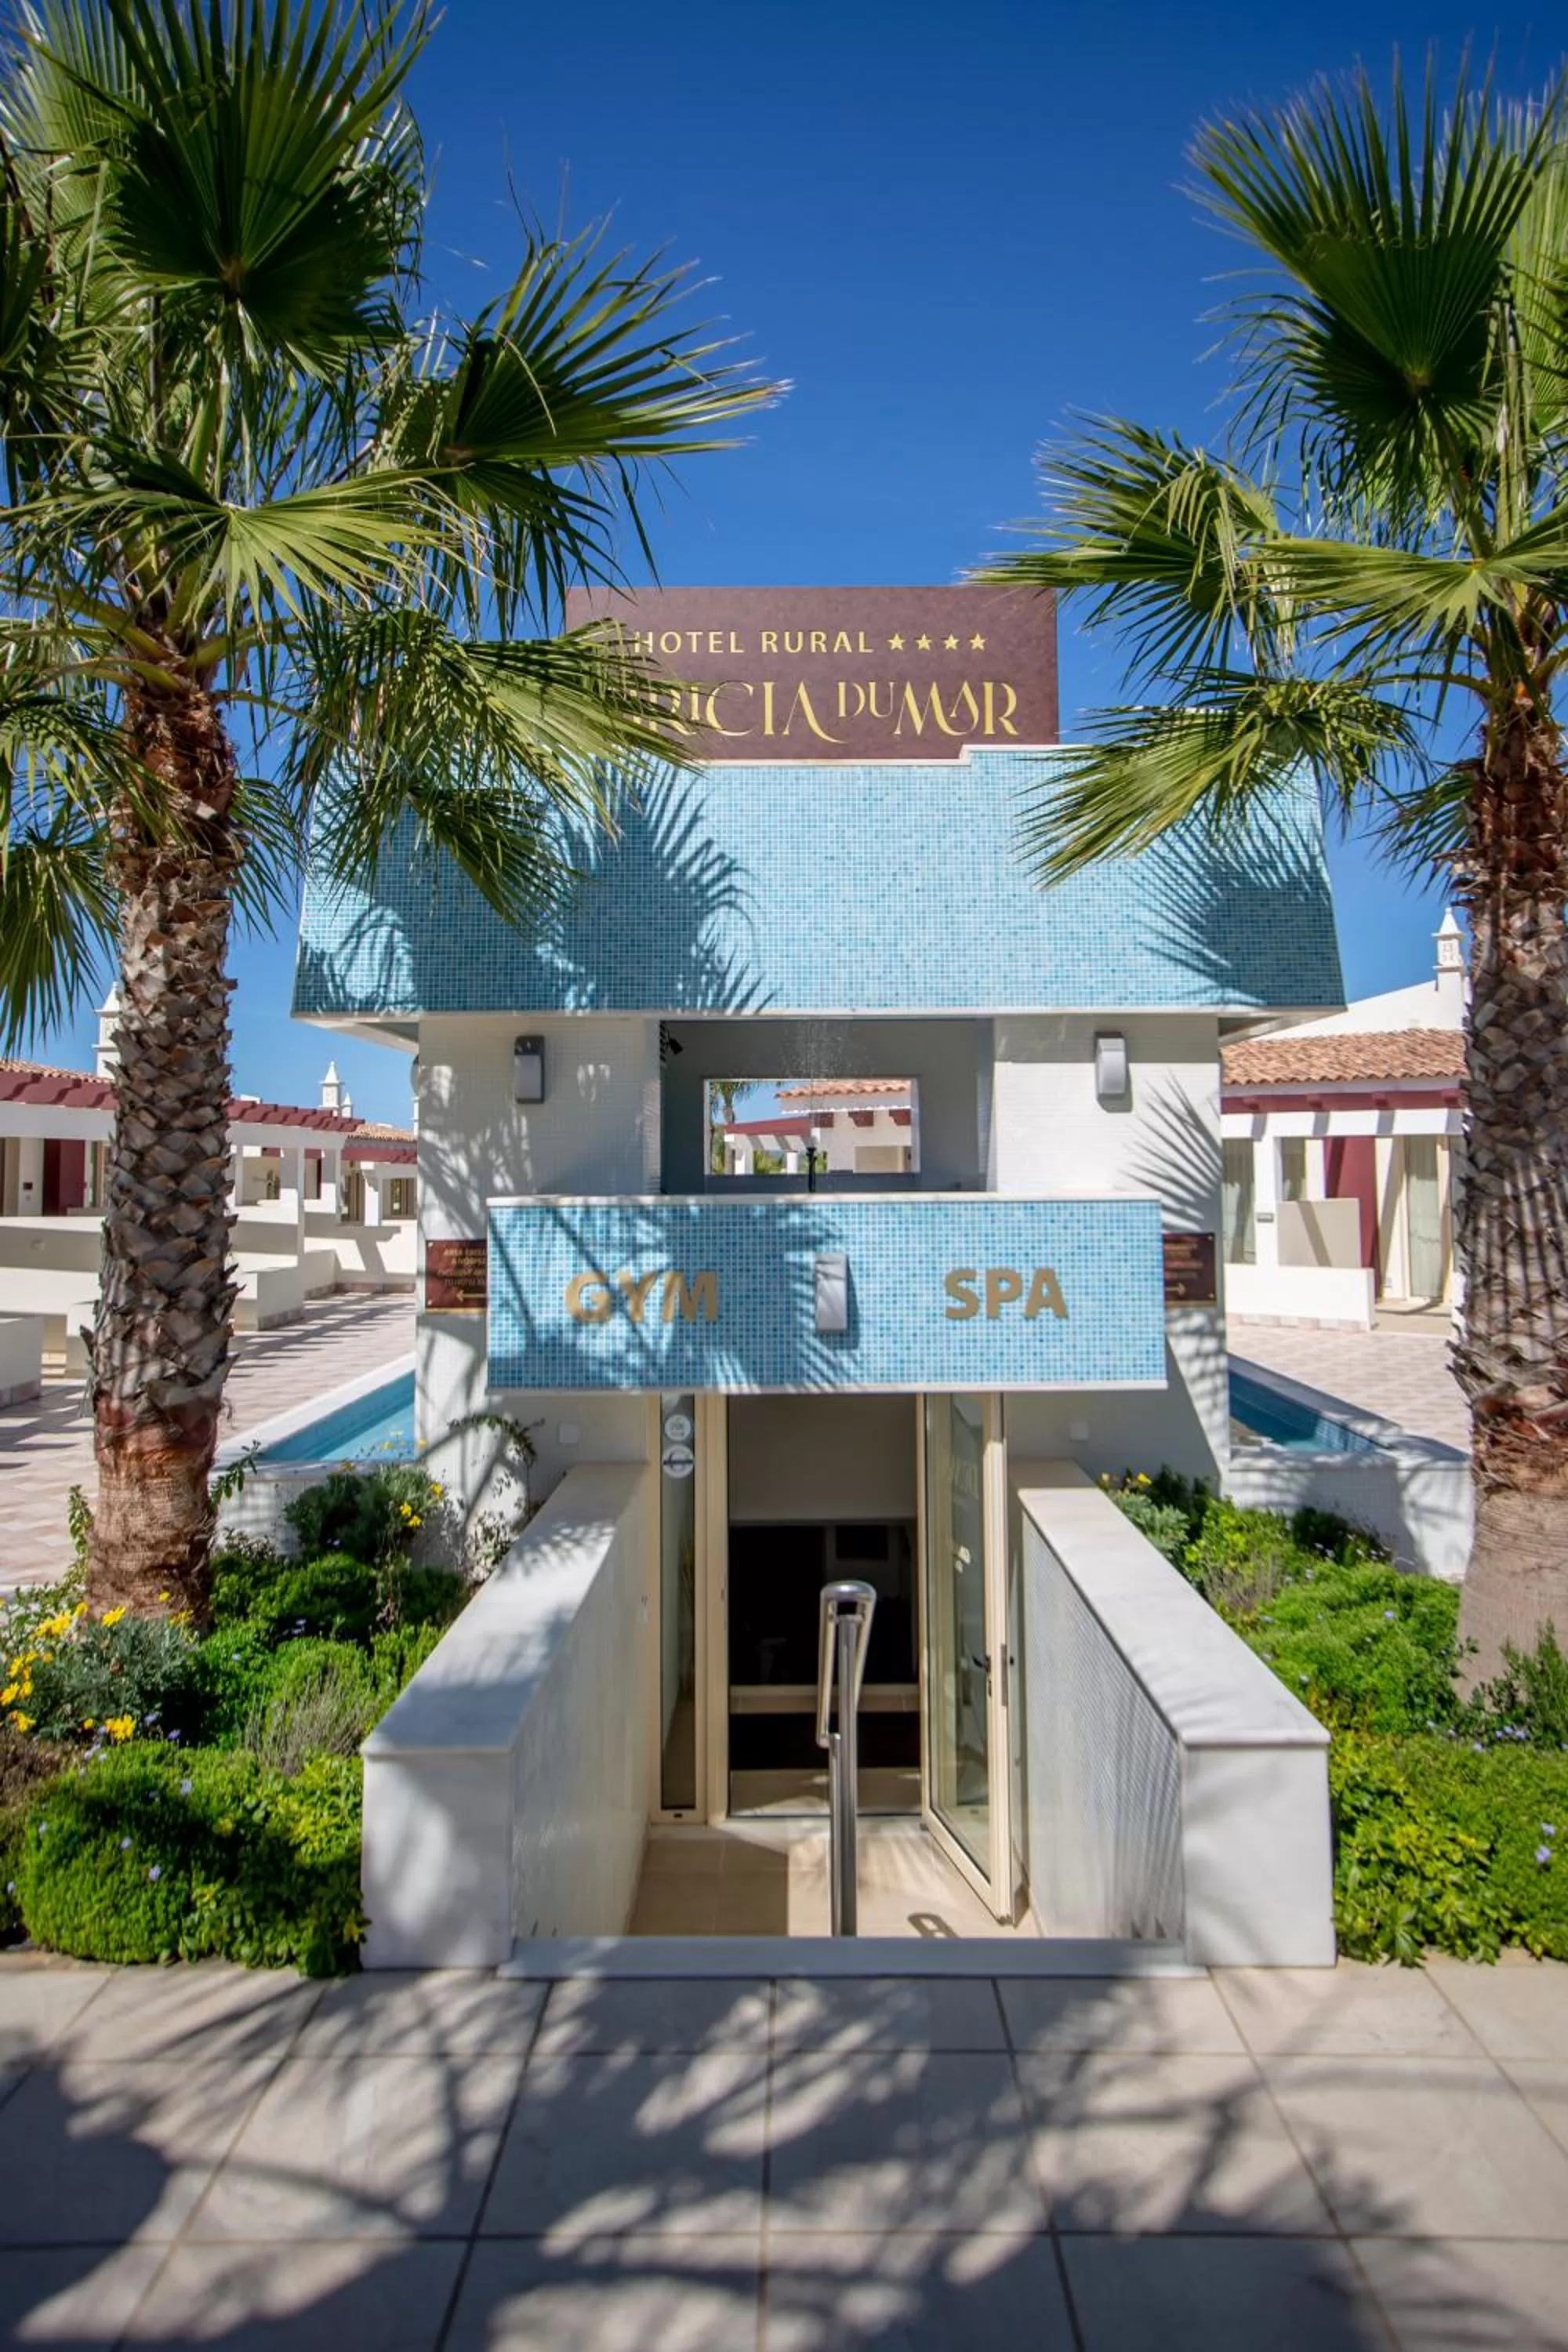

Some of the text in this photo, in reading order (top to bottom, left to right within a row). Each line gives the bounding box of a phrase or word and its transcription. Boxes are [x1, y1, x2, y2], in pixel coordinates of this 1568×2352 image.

[633, 630, 873, 653] HOTEL RURAL
[564, 1270, 718, 1324] GYM
[945, 1267, 1069, 1320] SPA
